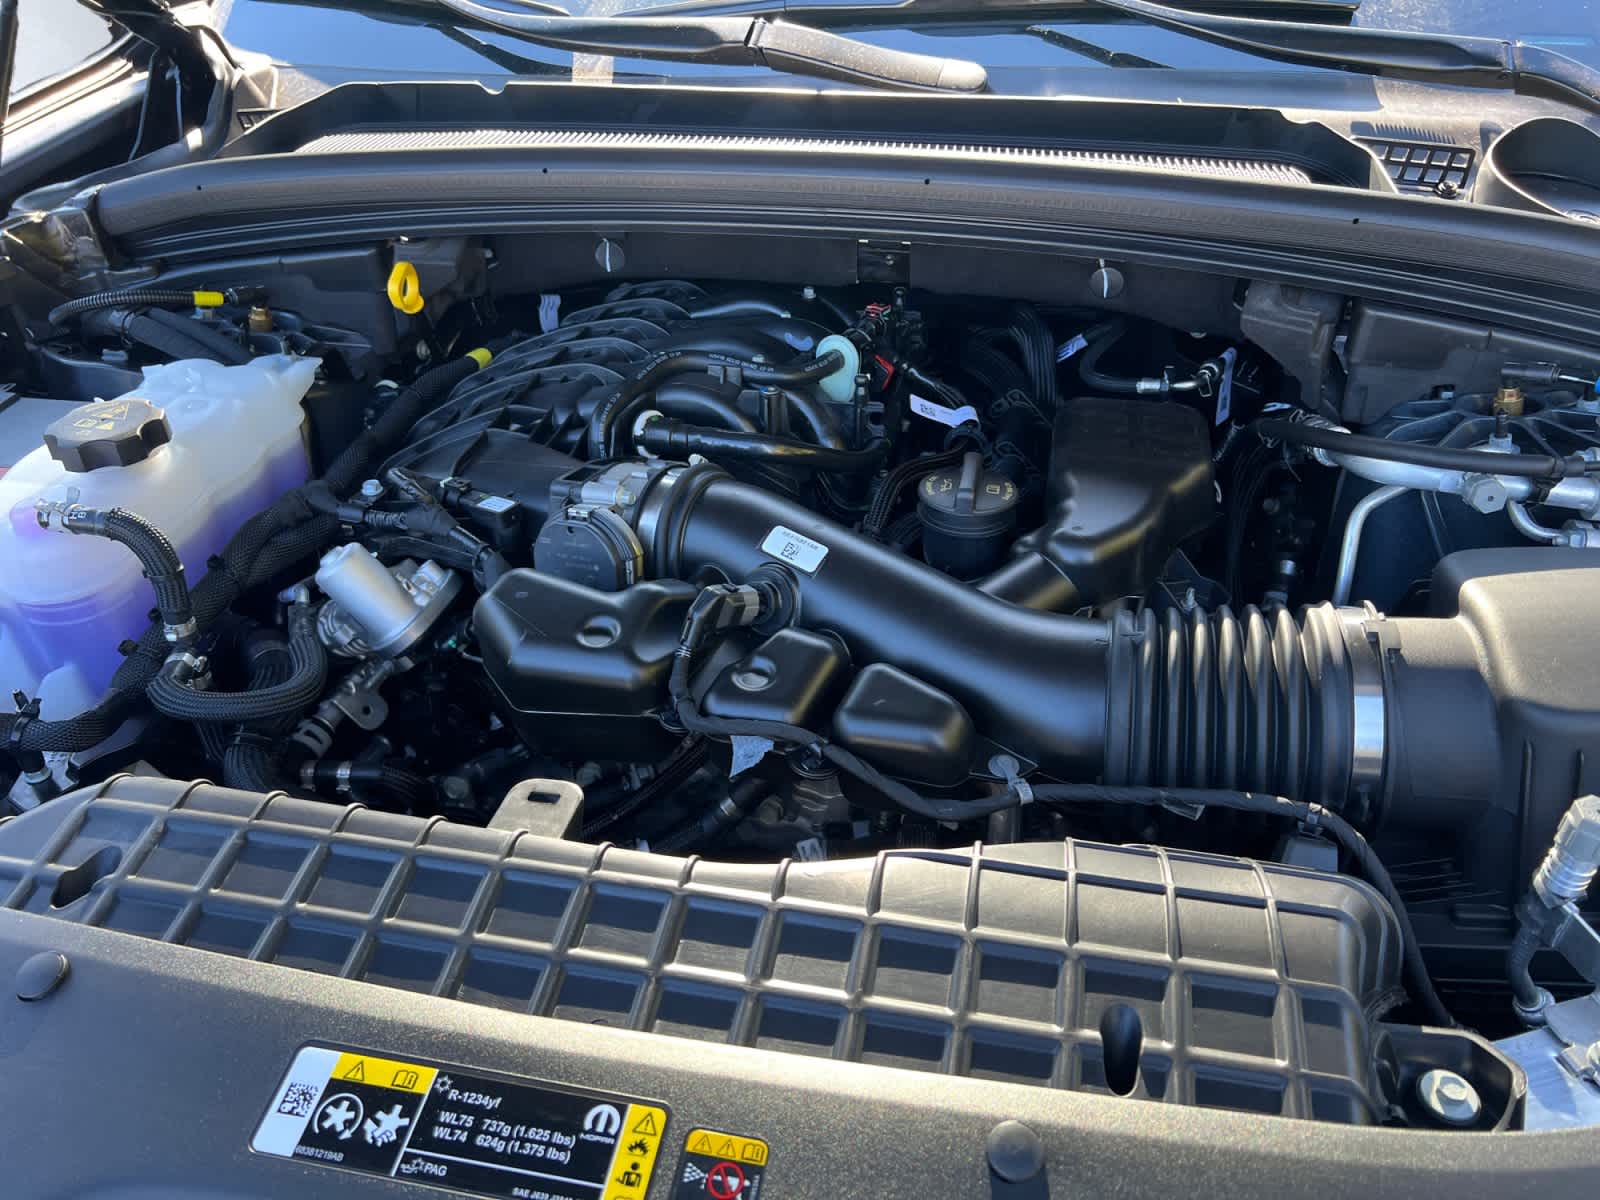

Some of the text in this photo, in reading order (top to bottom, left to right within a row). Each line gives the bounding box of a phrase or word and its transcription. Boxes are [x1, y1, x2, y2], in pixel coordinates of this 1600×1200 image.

[448, 1089, 502, 1110] R-1234yf
[439, 1111, 576, 1149] WL75 737g (1.625 lbs)
[432, 1126, 571, 1164] WL74 624g (1.375 lbs)
[423, 1162, 448, 1177] PAG
